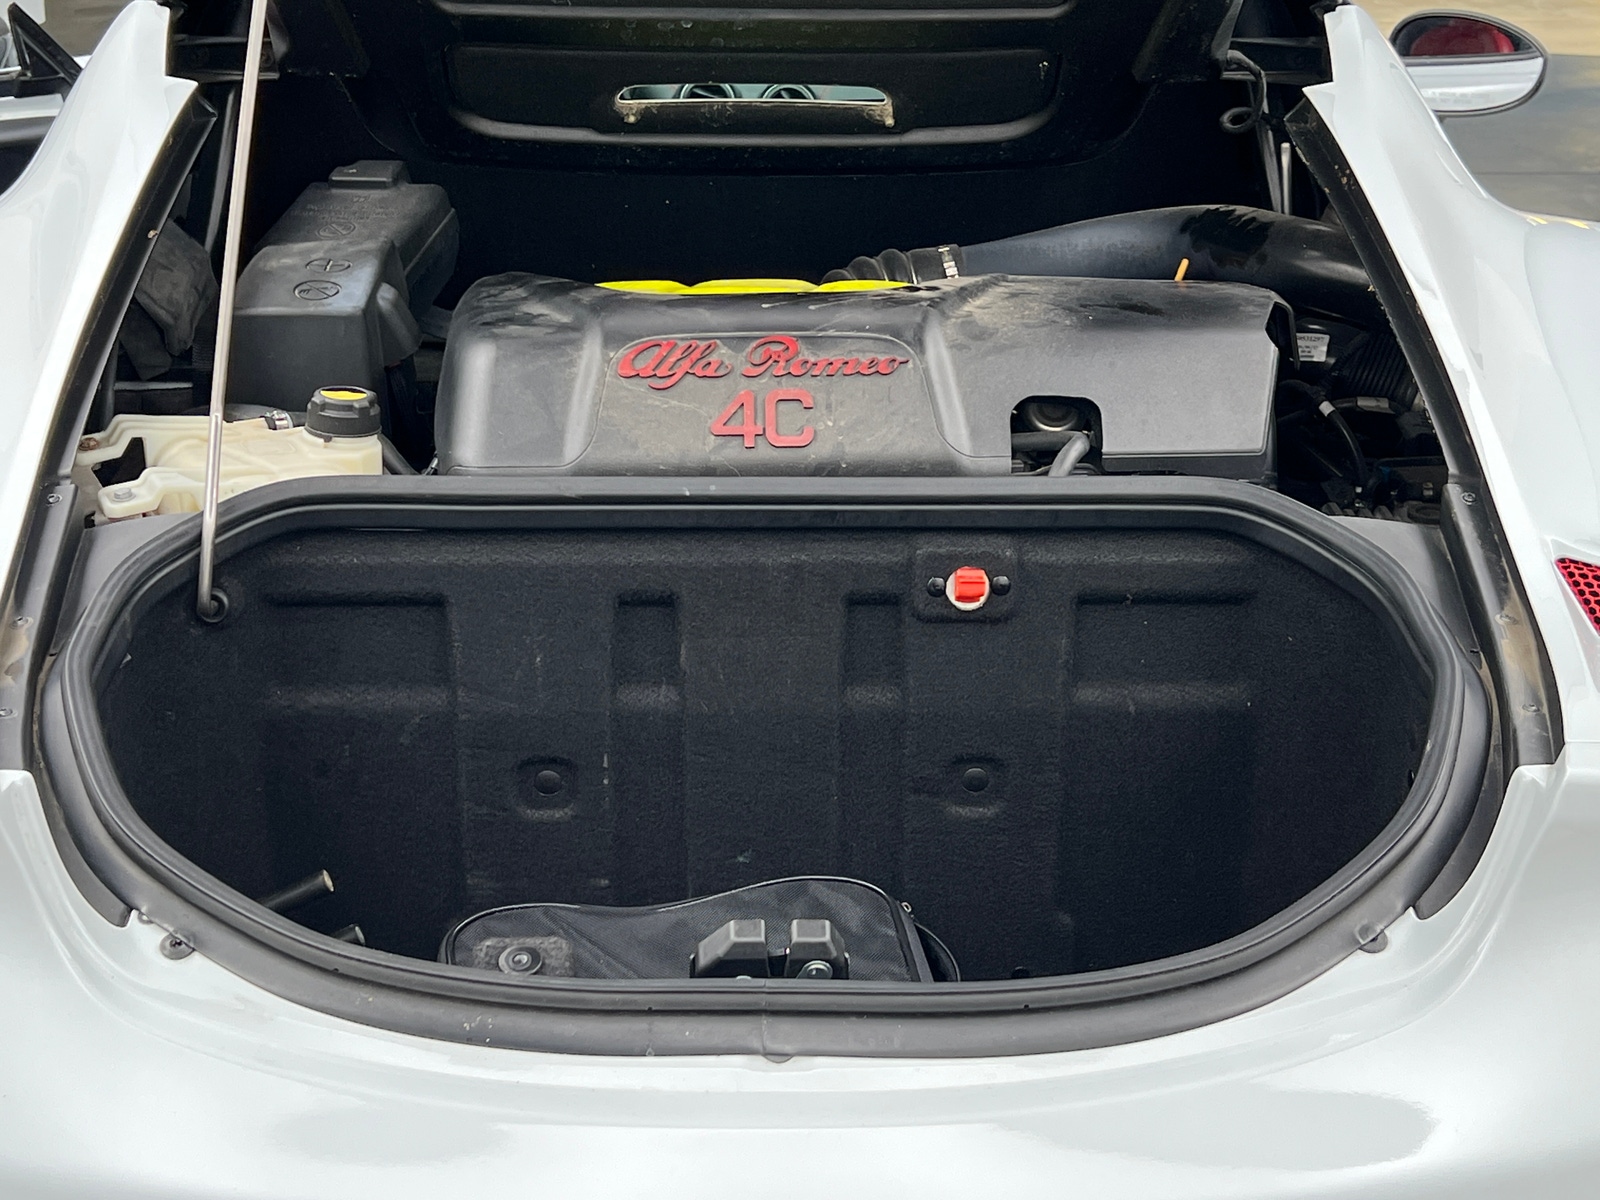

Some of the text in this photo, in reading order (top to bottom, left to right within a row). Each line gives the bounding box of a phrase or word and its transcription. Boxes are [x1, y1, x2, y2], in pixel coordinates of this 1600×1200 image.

[617, 335, 909, 390] Alfa Romeo
[710, 389, 815, 448] 4C
